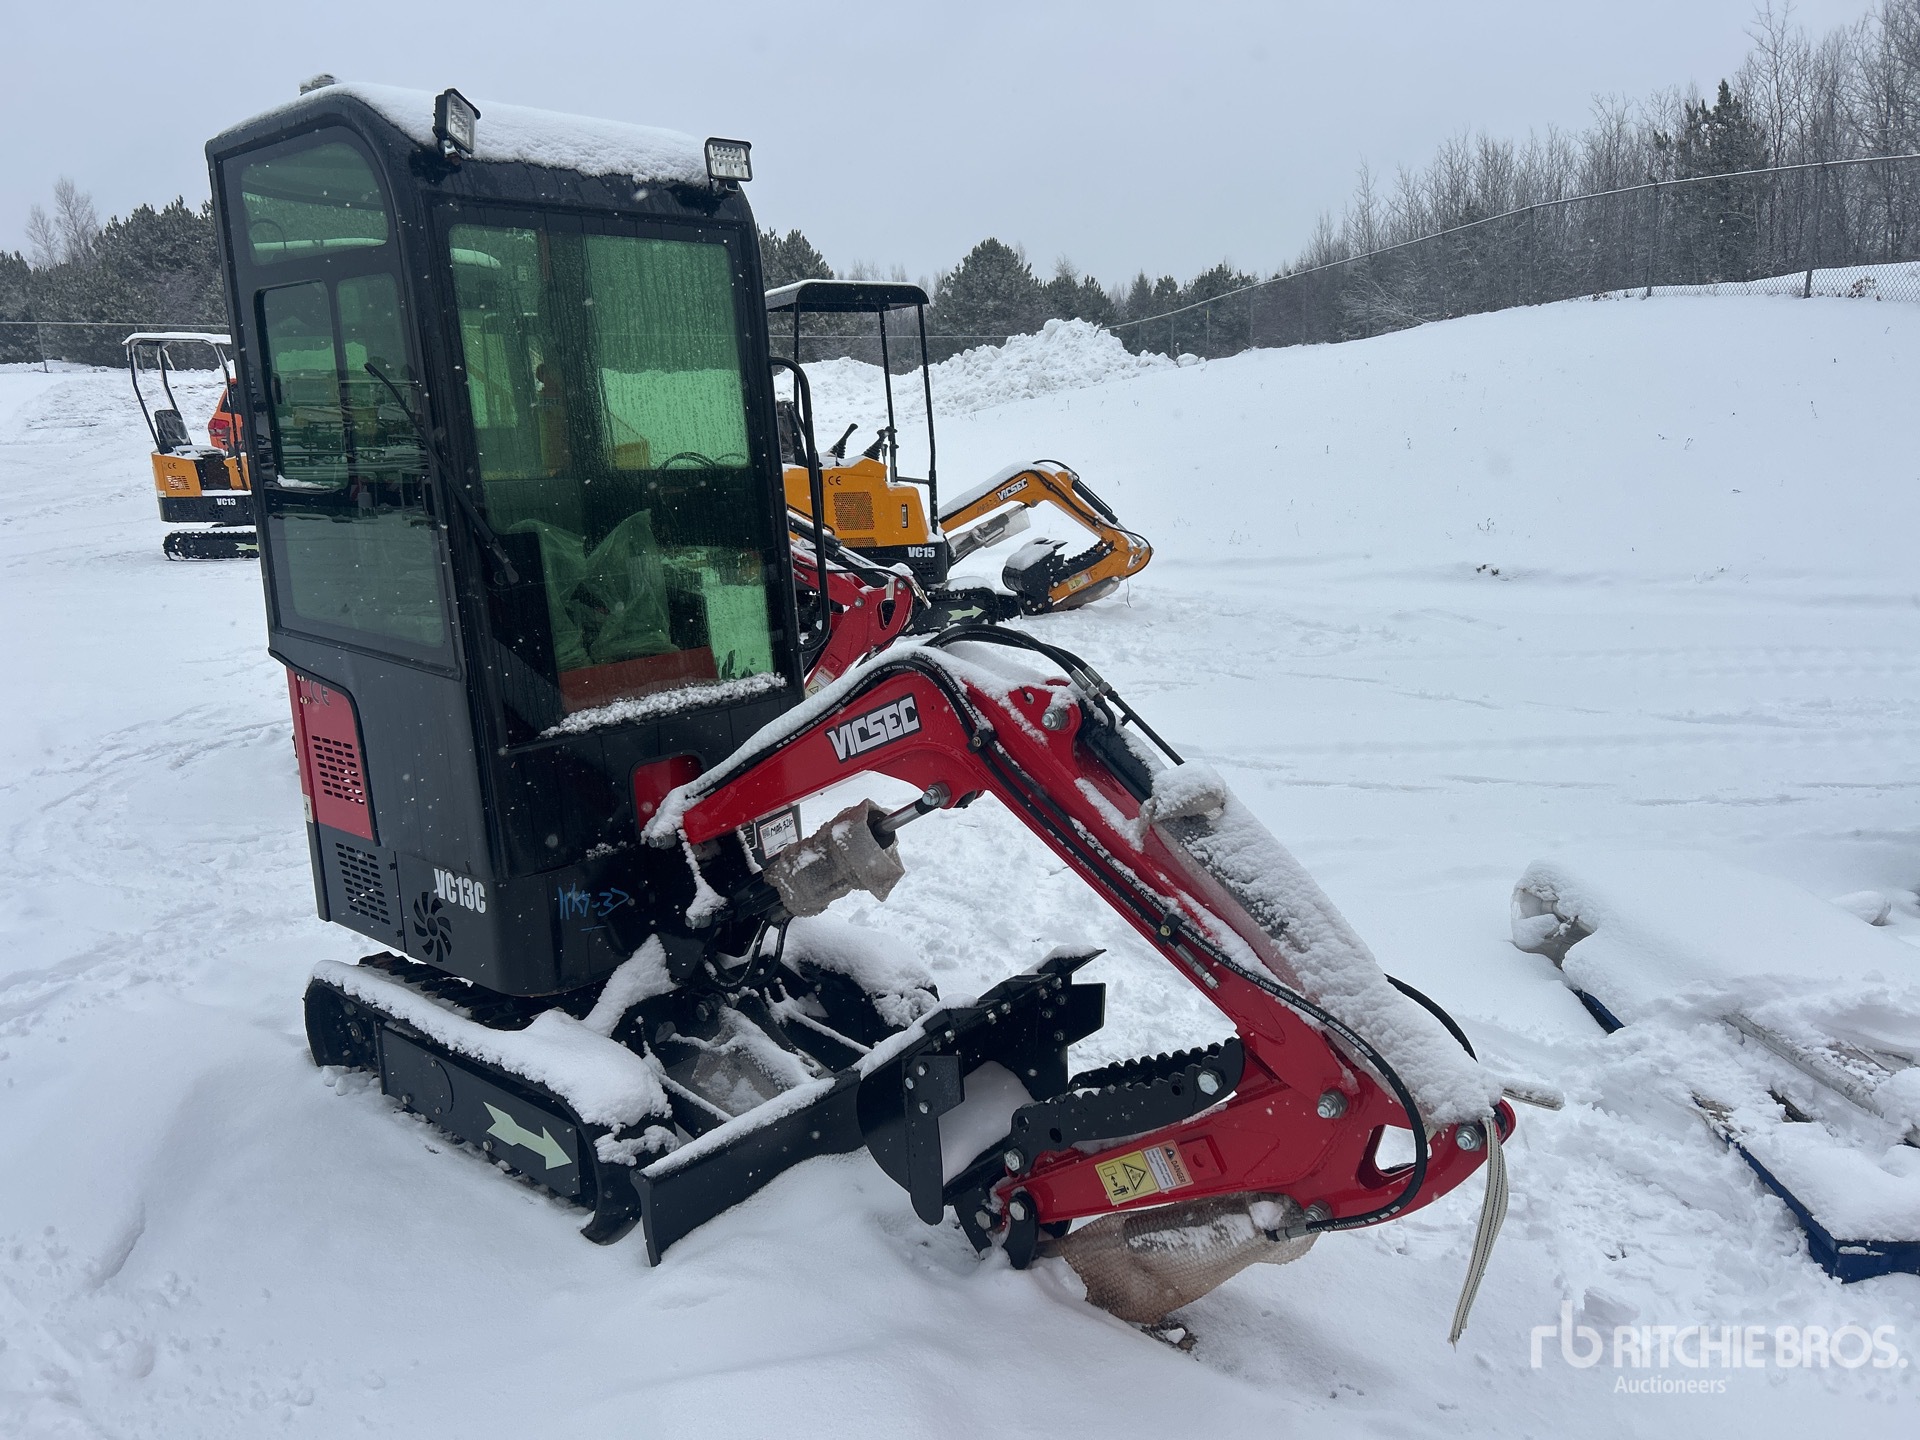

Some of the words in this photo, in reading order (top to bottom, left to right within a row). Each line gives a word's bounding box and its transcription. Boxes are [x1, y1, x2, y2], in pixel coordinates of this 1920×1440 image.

[828, 475, 841, 485] CE
[996, 477, 1029, 501] VICSEC
[216, 498, 236, 506] VC13
[907, 546, 936, 558] VC15
[826, 696, 921, 761] VICSEC
[433, 867, 487, 914] VC13C
[1170, 1160, 1186, 1183] DANGER
